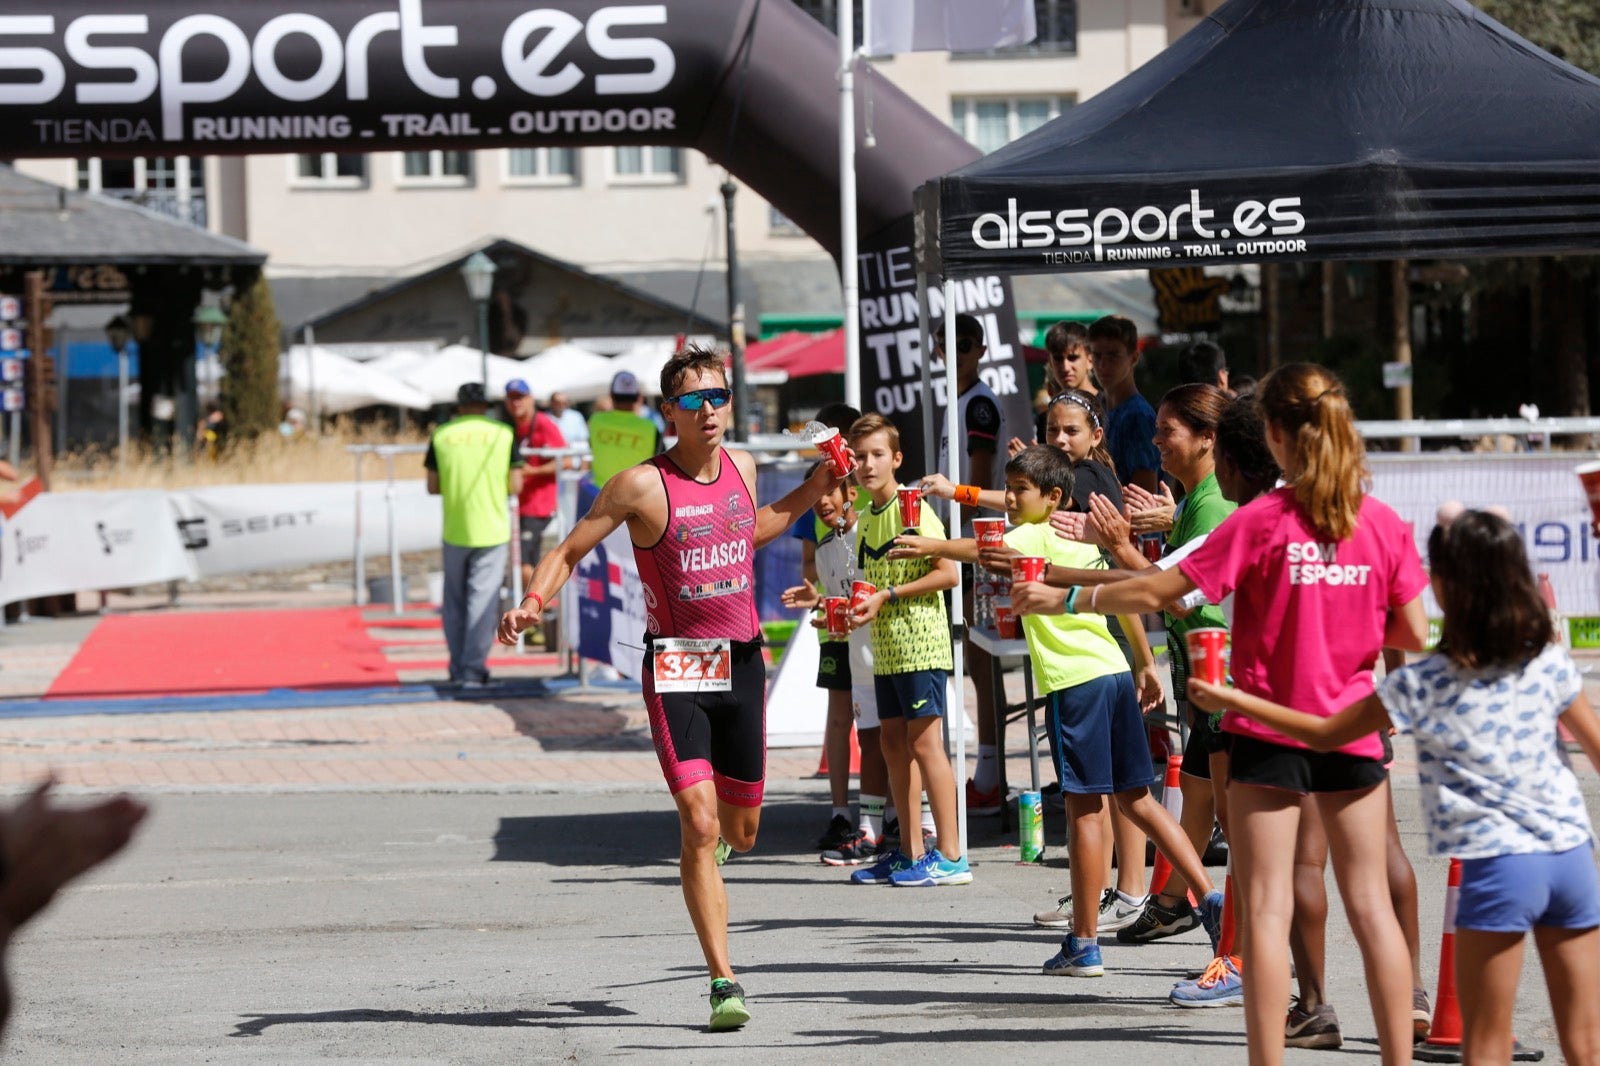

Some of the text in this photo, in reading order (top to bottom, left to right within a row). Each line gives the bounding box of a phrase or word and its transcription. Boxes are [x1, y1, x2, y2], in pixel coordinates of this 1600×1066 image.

[33, 107, 676, 143] TIENDA RUNNING TRAIL OUTDOOR
[972, 189, 1306, 262] alssport.es
[1042, 239, 1307, 264] TIENDA RUNNING TRAIL OUTDOOR
[860, 275, 1004, 329] RUNNING
[221, 511, 318, 537] SEAT
[680, 539, 747, 572] VELASCO
[1286, 541, 1337, 563] SOM
[1288, 564, 1372, 586] ESPORT
[663, 655, 721, 678] 327
